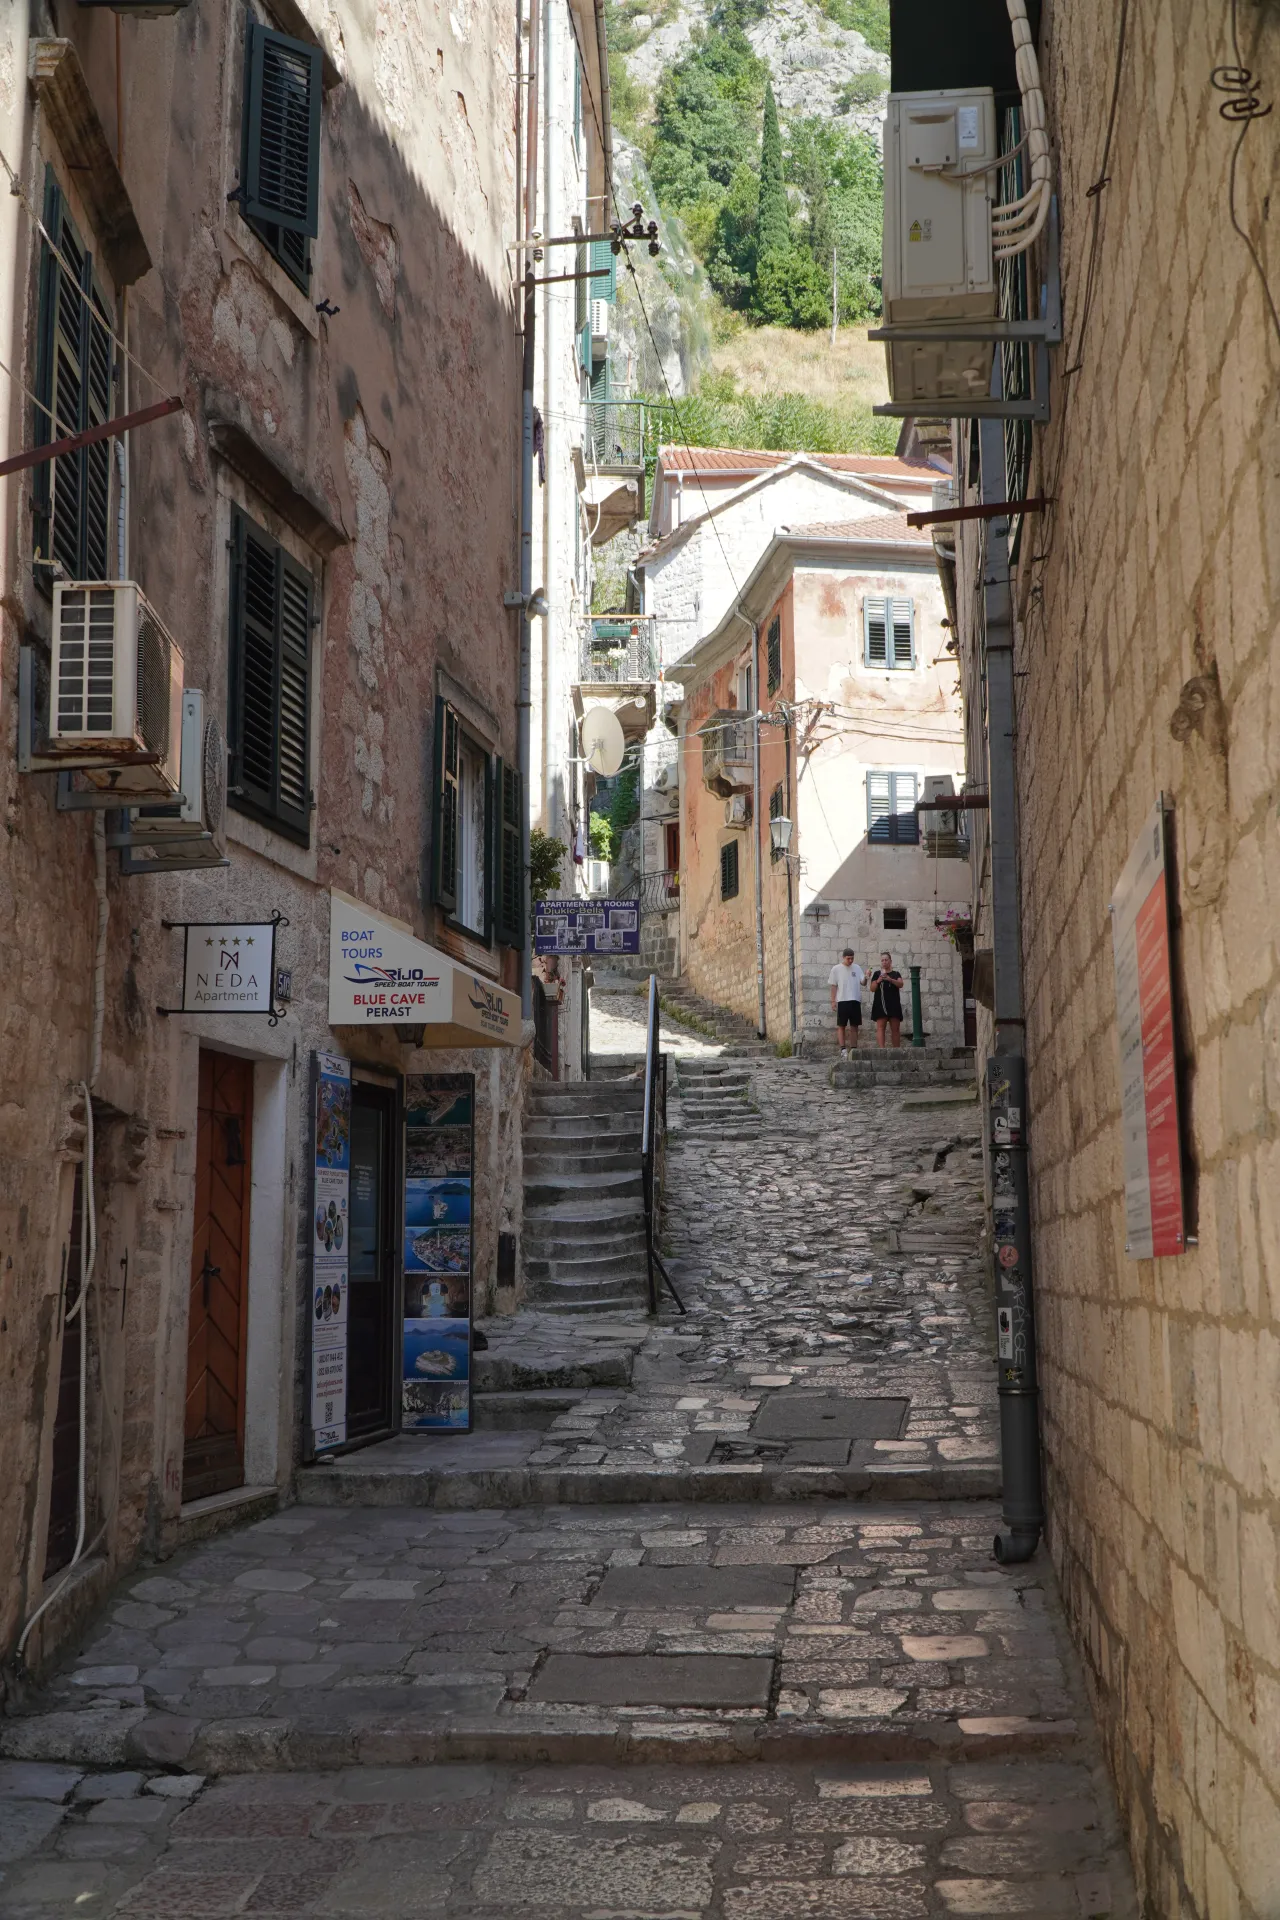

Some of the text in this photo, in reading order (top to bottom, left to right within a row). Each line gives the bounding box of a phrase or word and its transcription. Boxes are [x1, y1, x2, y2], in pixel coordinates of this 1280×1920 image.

[342, 930, 374, 941] BOAT
[342, 948, 382, 958] TOURS
[197, 973, 258, 988] NEDA
[194, 990, 259, 1003] Apartment
[354, 994, 425, 1005] BLUE CAVE
[366, 1007, 411, 1017] PERAST
